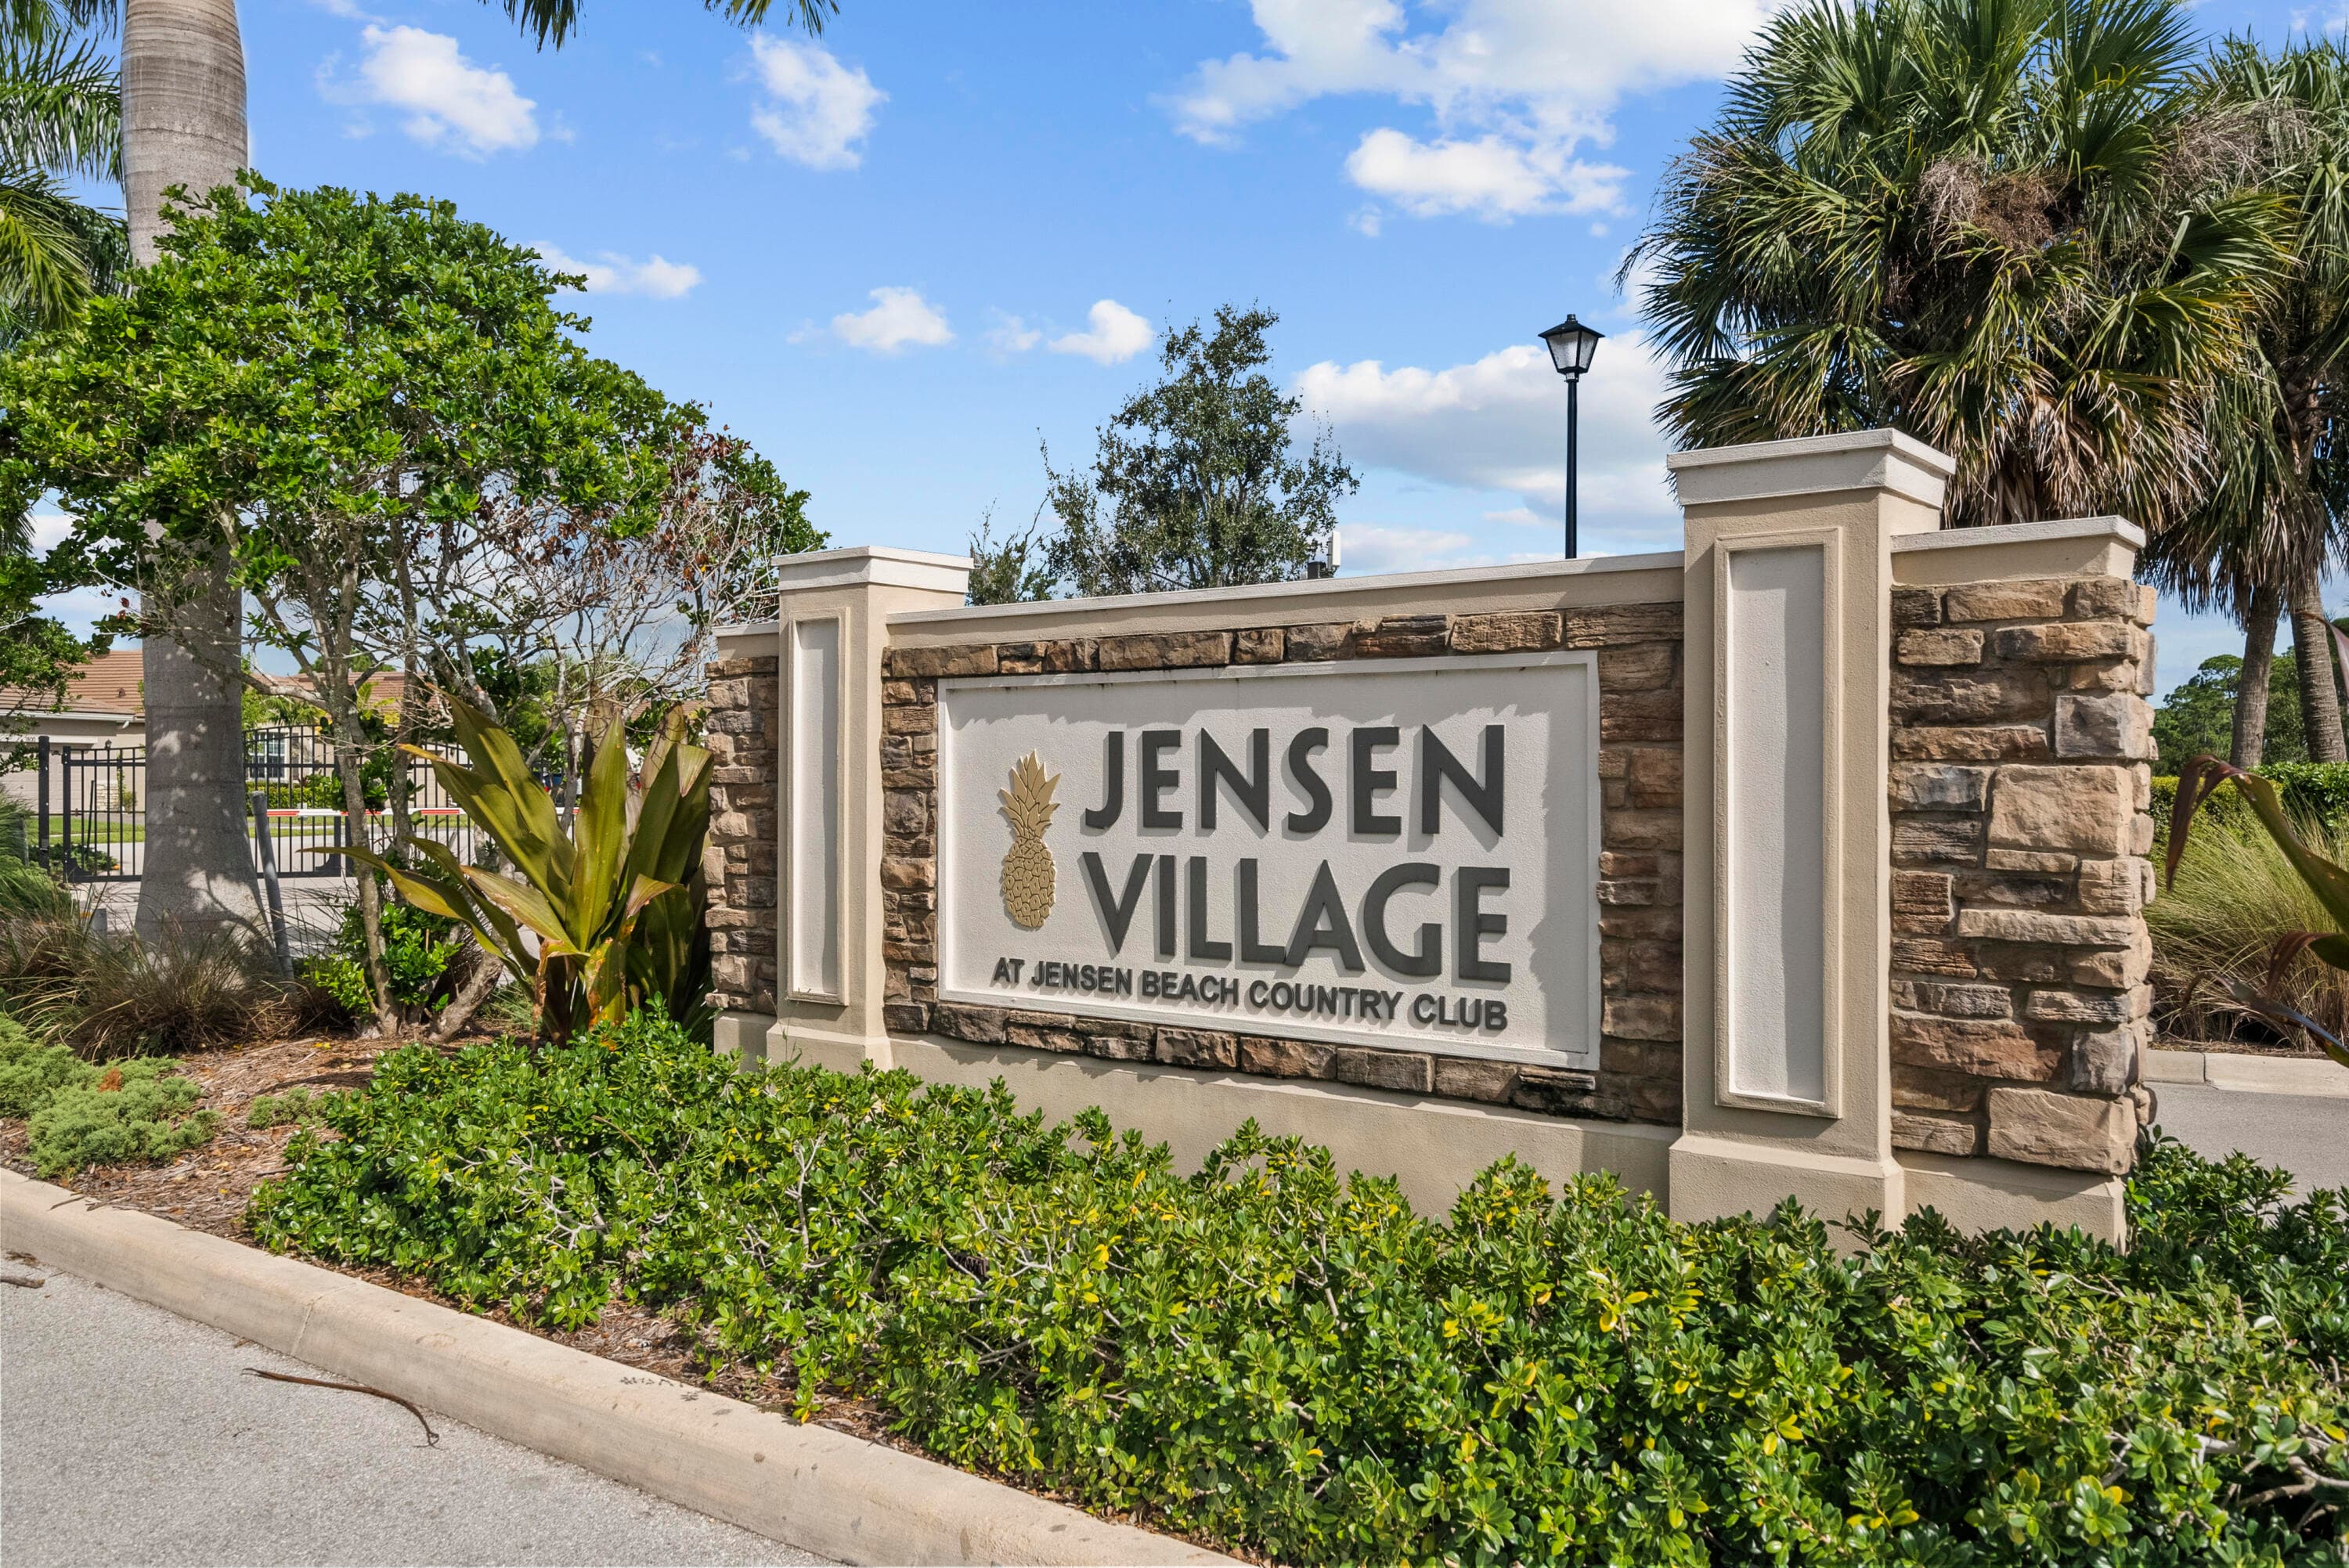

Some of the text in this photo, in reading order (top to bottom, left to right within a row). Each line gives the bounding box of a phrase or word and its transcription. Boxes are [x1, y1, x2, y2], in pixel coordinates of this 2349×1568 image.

[1084, 723, 1505, 837] JENSEN
[1082, 851, 1511, 983] VILLAGE
[993, 957, 1508, 1031] AT JENSEN BEACH COUNTRY CLUB
